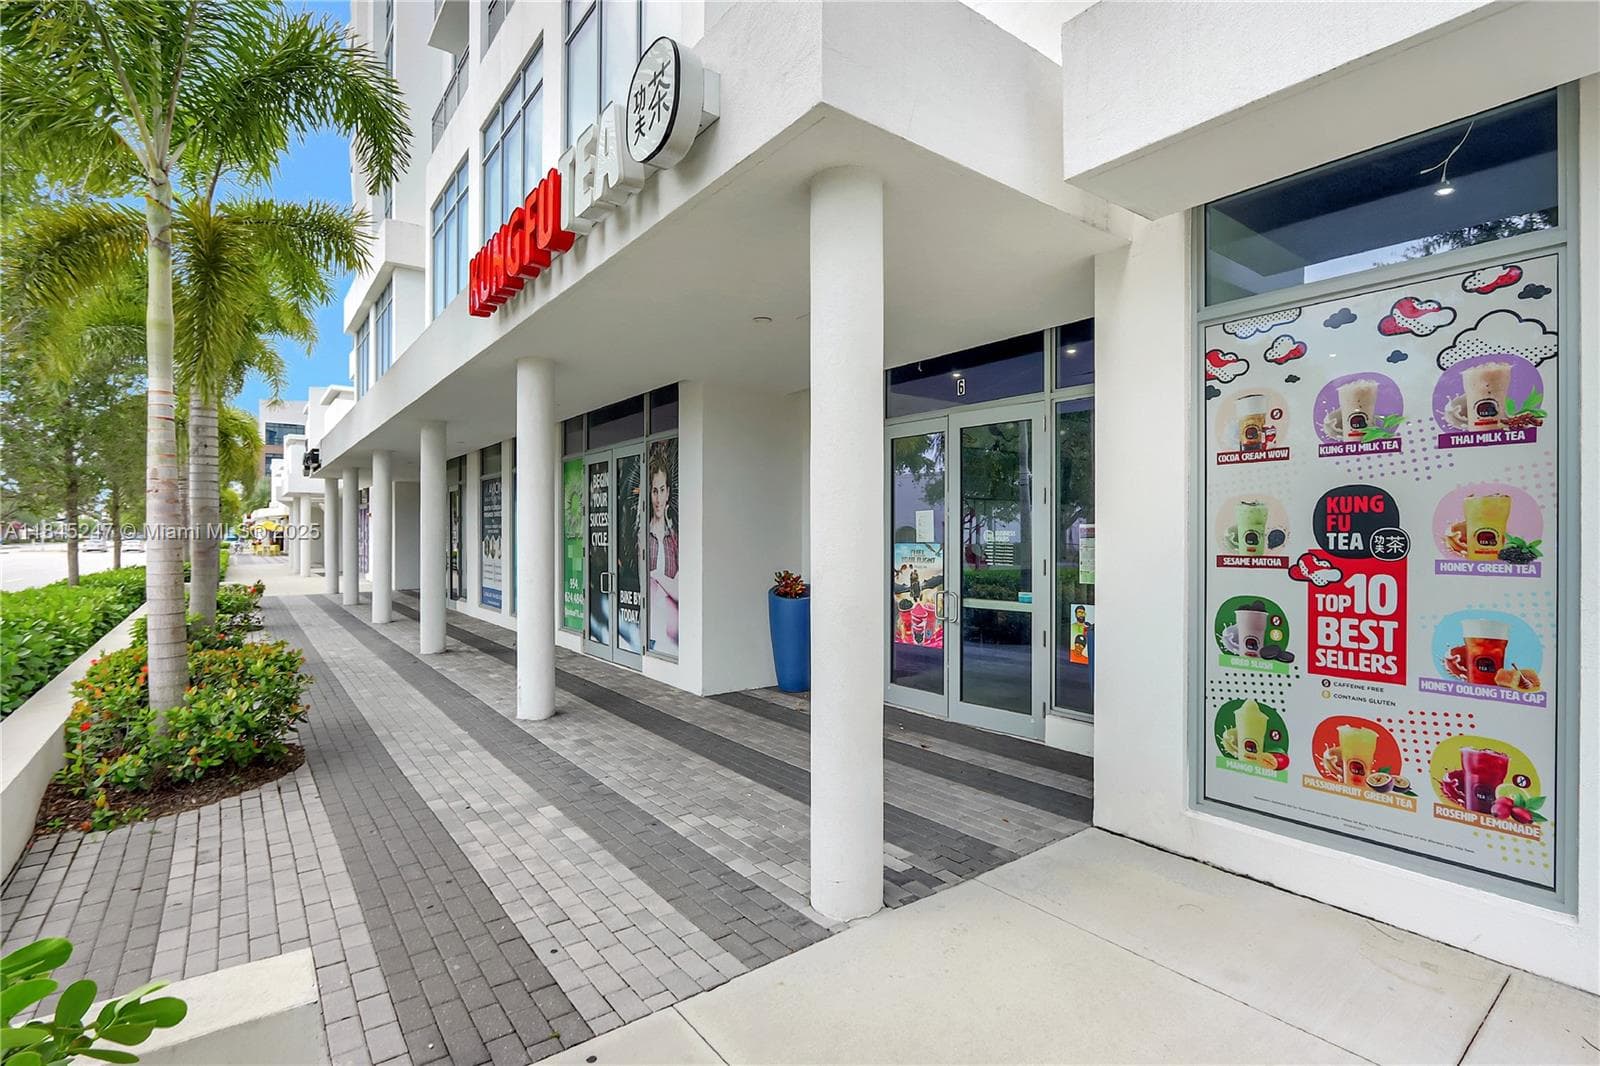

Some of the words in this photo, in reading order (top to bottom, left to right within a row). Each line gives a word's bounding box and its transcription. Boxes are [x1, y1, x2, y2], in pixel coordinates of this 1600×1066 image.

[647, 59, 671, 131] 茶
[632, 88, 647, 146] 功夫
[558, 101, 634, 235] TEA
[1450, 436, 1474, 445] THAI
[1476, 432, 1502, 443] MILK
[1505, 430, 1526, 441] TEA
[1218, 454, 1240, 463] COCOA
[1241, 452, 1267, 461] CREAM
[1267, 449, 1289, 459] WOW
[1320, 444, 1344, 455] KUNG
[1345, 444, 1357, 453] FU
[1358, 441, 1380, 452] MILK
[1381, 440, 1399, 450] TEA
[1326, 495, 1384, 513] KUNG
[1326, 515, 1351, 532] FU
[1326, 532, 1364, 550] TEA
[1385, 535, 1405, 554] 茶
[1223, 558, 1250, 566] SESAME
[1252, 558, 1281, 566] MATCHA
[1440, 562, 1473, 572] HONEY
[1477, 563, 1512, 574] GREEN
[1515, 564, 1536, 574] TEA
[1315, 593, 1352, 613] TOP
[1344, 573, 1398, 616] 10
[1317, 616, 1399, 652] BEST
[1315, 648, 1398, 675] SELLERS
[1333, 682, 1365, 691] CAFFEINE
[1421, 680, 1453, 692] HONEY
[1456, 684, 1497, 698] OOLONG
[1500, 689, 1519, 701] TEA
[1522, 693, 1545, 703] CAP
[1333, 693, 1367, 703] CONTAINS
[1368, 698, 1396, 707] GLUTEN
[1304, 777, 1361, 797] PASSIONFRUIT
[1363, 790, 1393, 803] GREEN
[1395, 797, 1412, 808] TEA
[1435, 806, 1478, 822] ROSEHIP
[1480, 815, 1540, 837] LEMONADE
